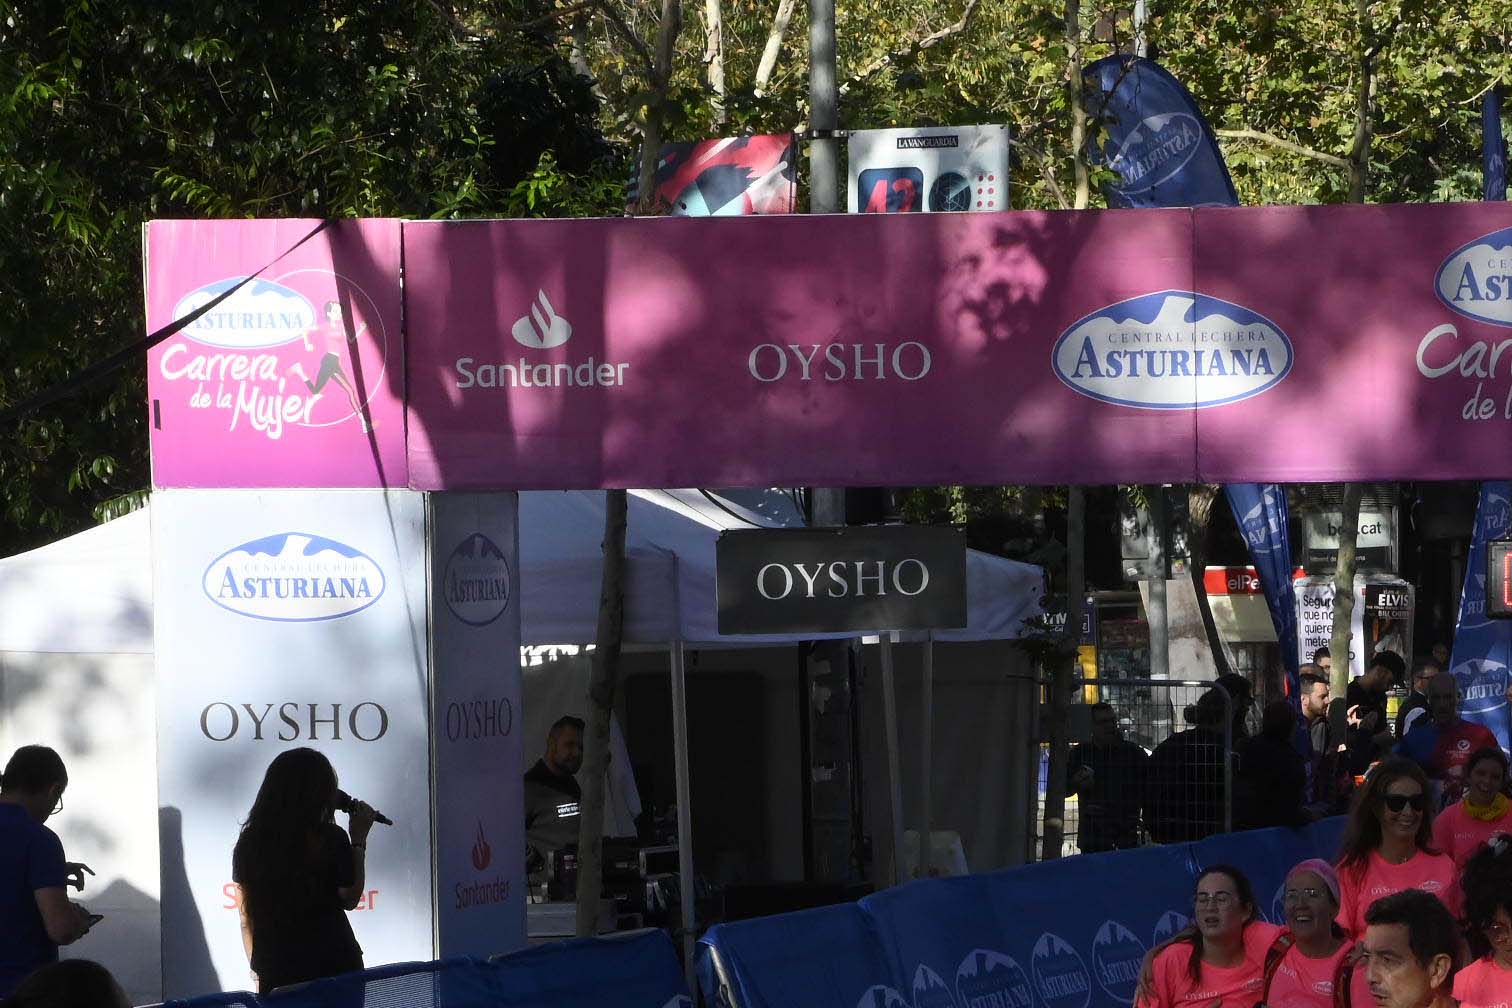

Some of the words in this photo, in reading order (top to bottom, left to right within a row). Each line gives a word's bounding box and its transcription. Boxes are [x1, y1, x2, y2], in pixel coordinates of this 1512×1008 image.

[1109, 333, 1183, 345] CENTRAL
[1192, 331, 1266, 343] LECHERA
[160, 344, 279, 380] Carrera
[455, 357, 630, 389] Santander
[748, 341, 933, 383] OYSHO
[1071, 336, 1275, 379] ASTURIANA
[190, 384, 213, 408] de
[216, 382, 233, 408] la
[229, 377, 323, 439] Mujer
[1462, 382, 1496, 420] de
[217, 566, 374, 599] ASTURIANA
[452, 574, 507, 603] ASTURIANA
[756, 558, 929, 600] OYSHO
[1379, 594, 1408, 607] ELVIS
[200, 692, 390, 743] OYSHO
[446, 697, 513, 743] OYSHO
[454, 874, 512, 910] Santander
[1037, 967, 1088, 1000] ASTURIANA
